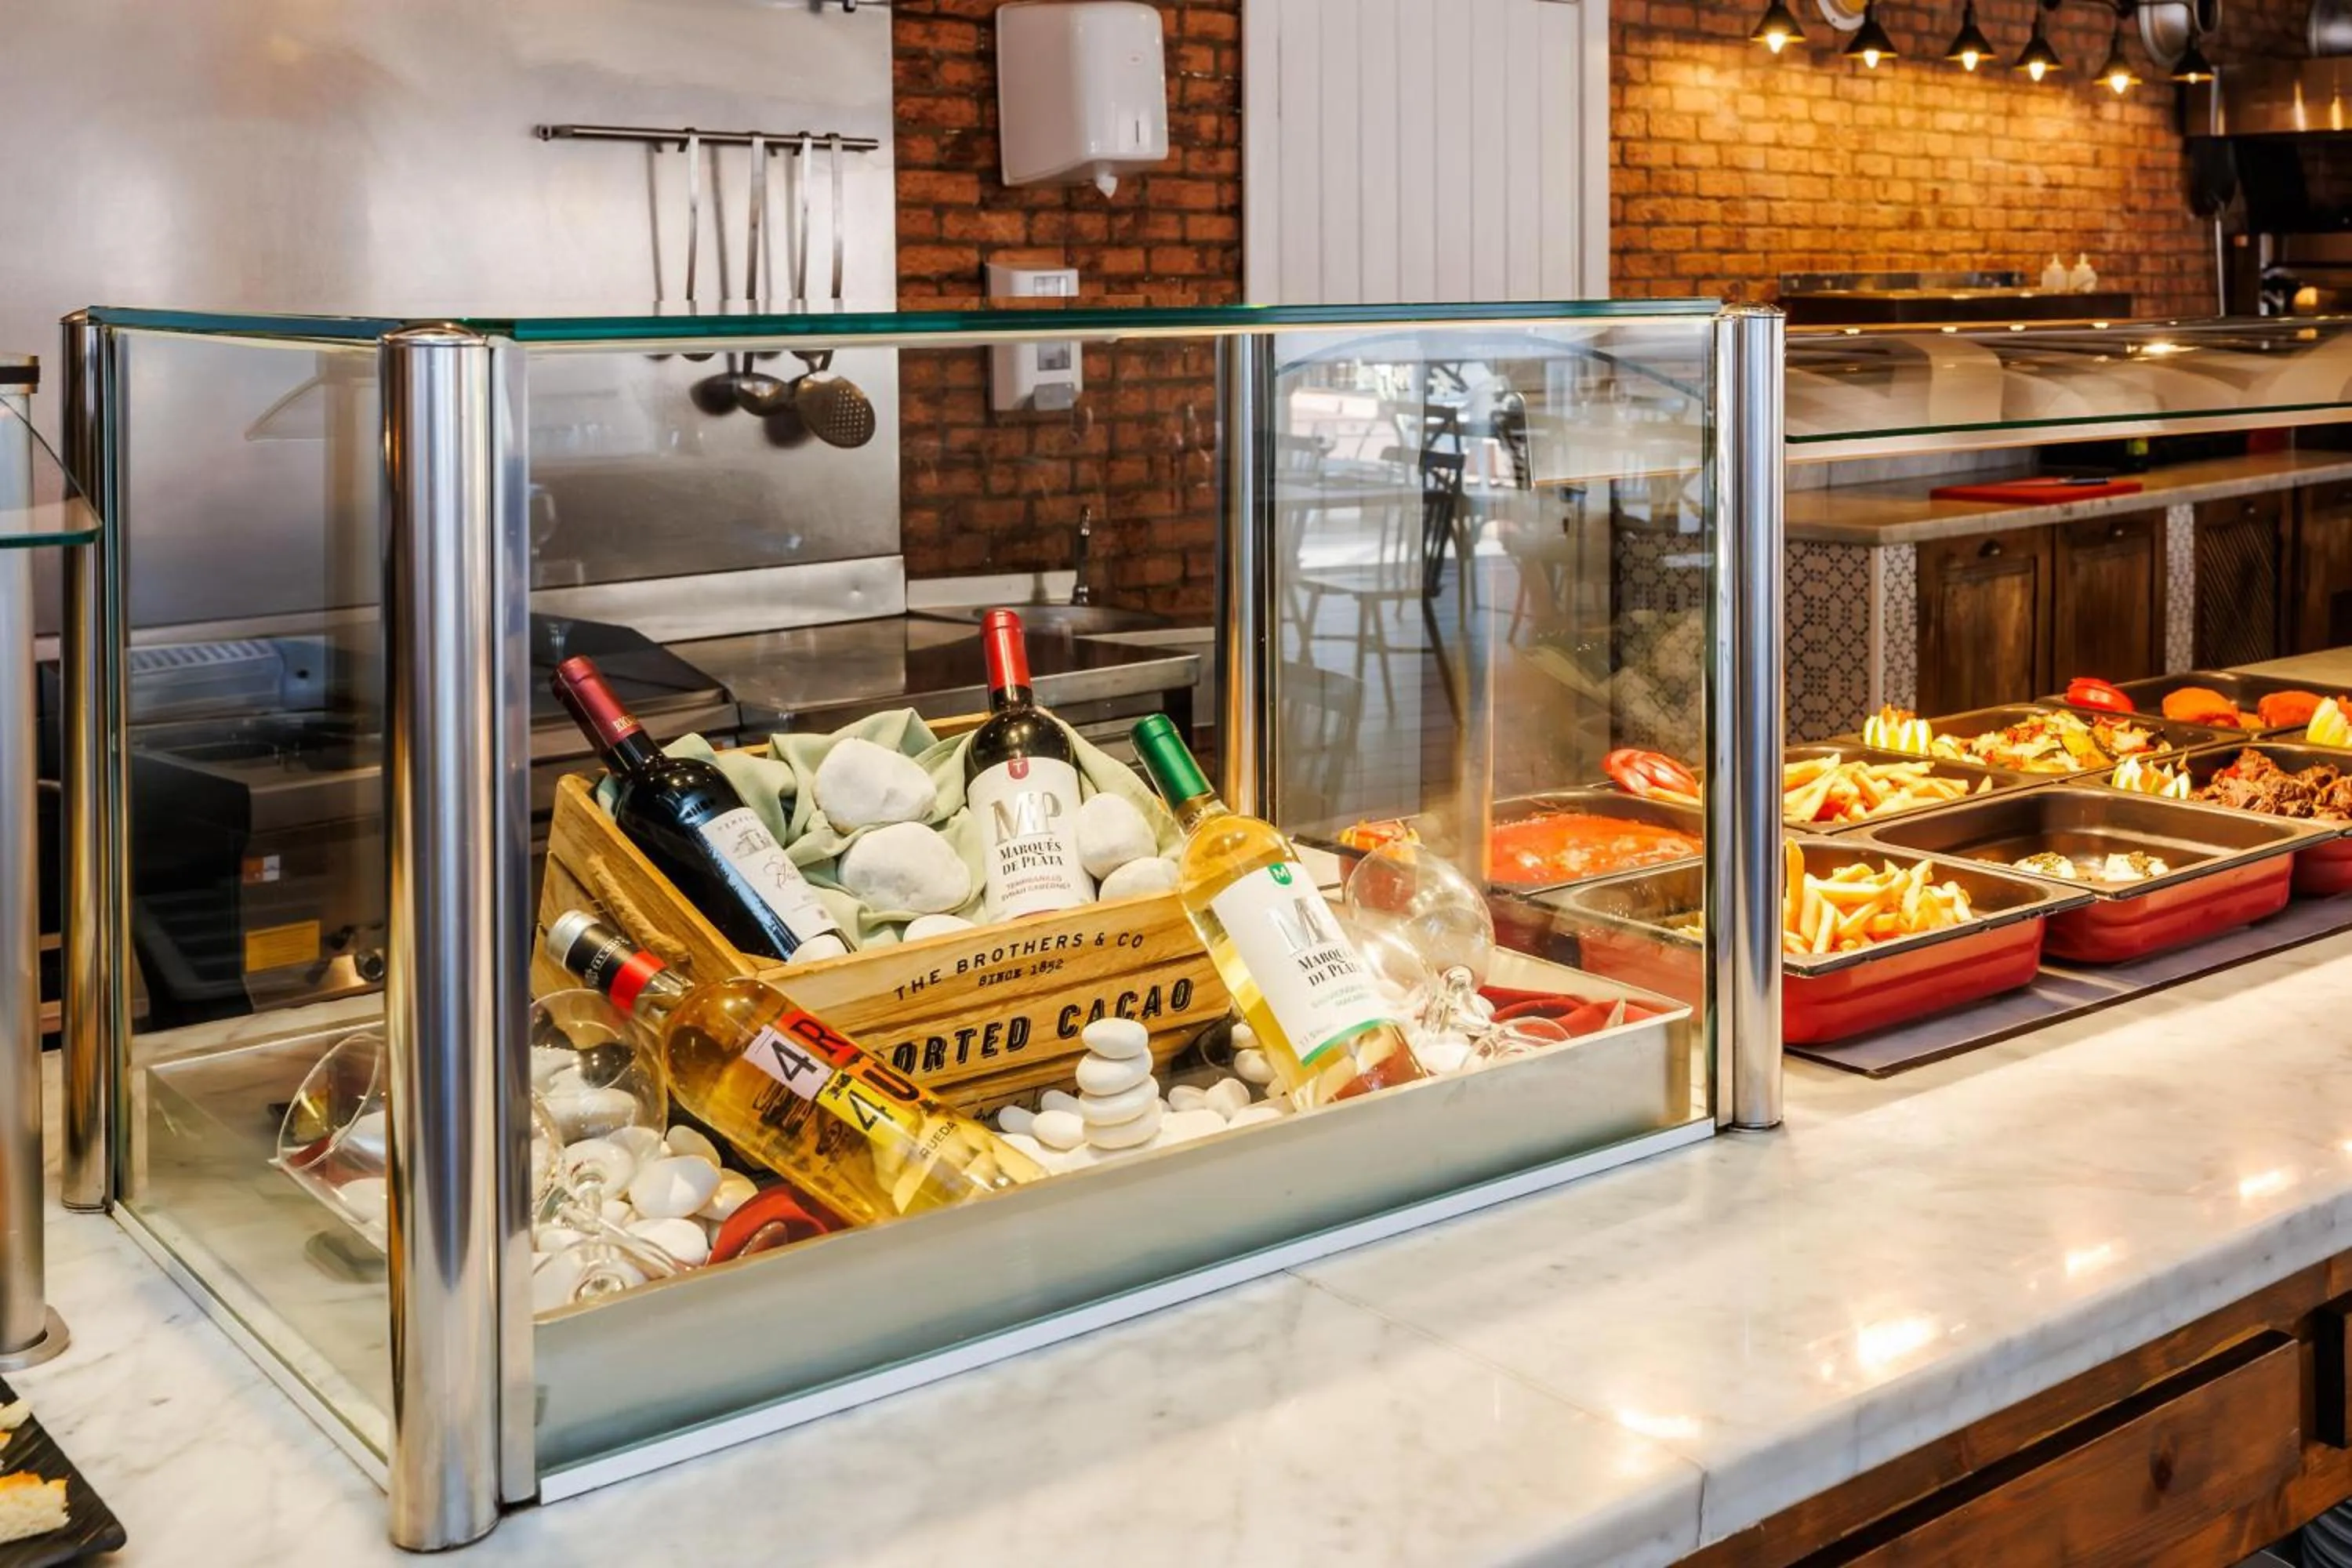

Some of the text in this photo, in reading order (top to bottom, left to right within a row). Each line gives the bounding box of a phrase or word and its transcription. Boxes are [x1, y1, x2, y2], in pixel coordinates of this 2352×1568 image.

[1010, 760, 1025, 775] T
[999, 837, 1063, 860] MARQUÉS
[1003, 855, 1064, 876] DE PLATA
[1272, 866, 1288, 881] M
[894, 931, 1145, 1001] THE BROTHERS & CO
[1298, 947, 1352, 972] MARQU
[978, 958, 1065, 988] SINCE 1852
[1308, 968, 1330, 987] DE
[873, 1016, 1032, 1077] ORTED
[918, 1120, 958, 1160] RUEDA
